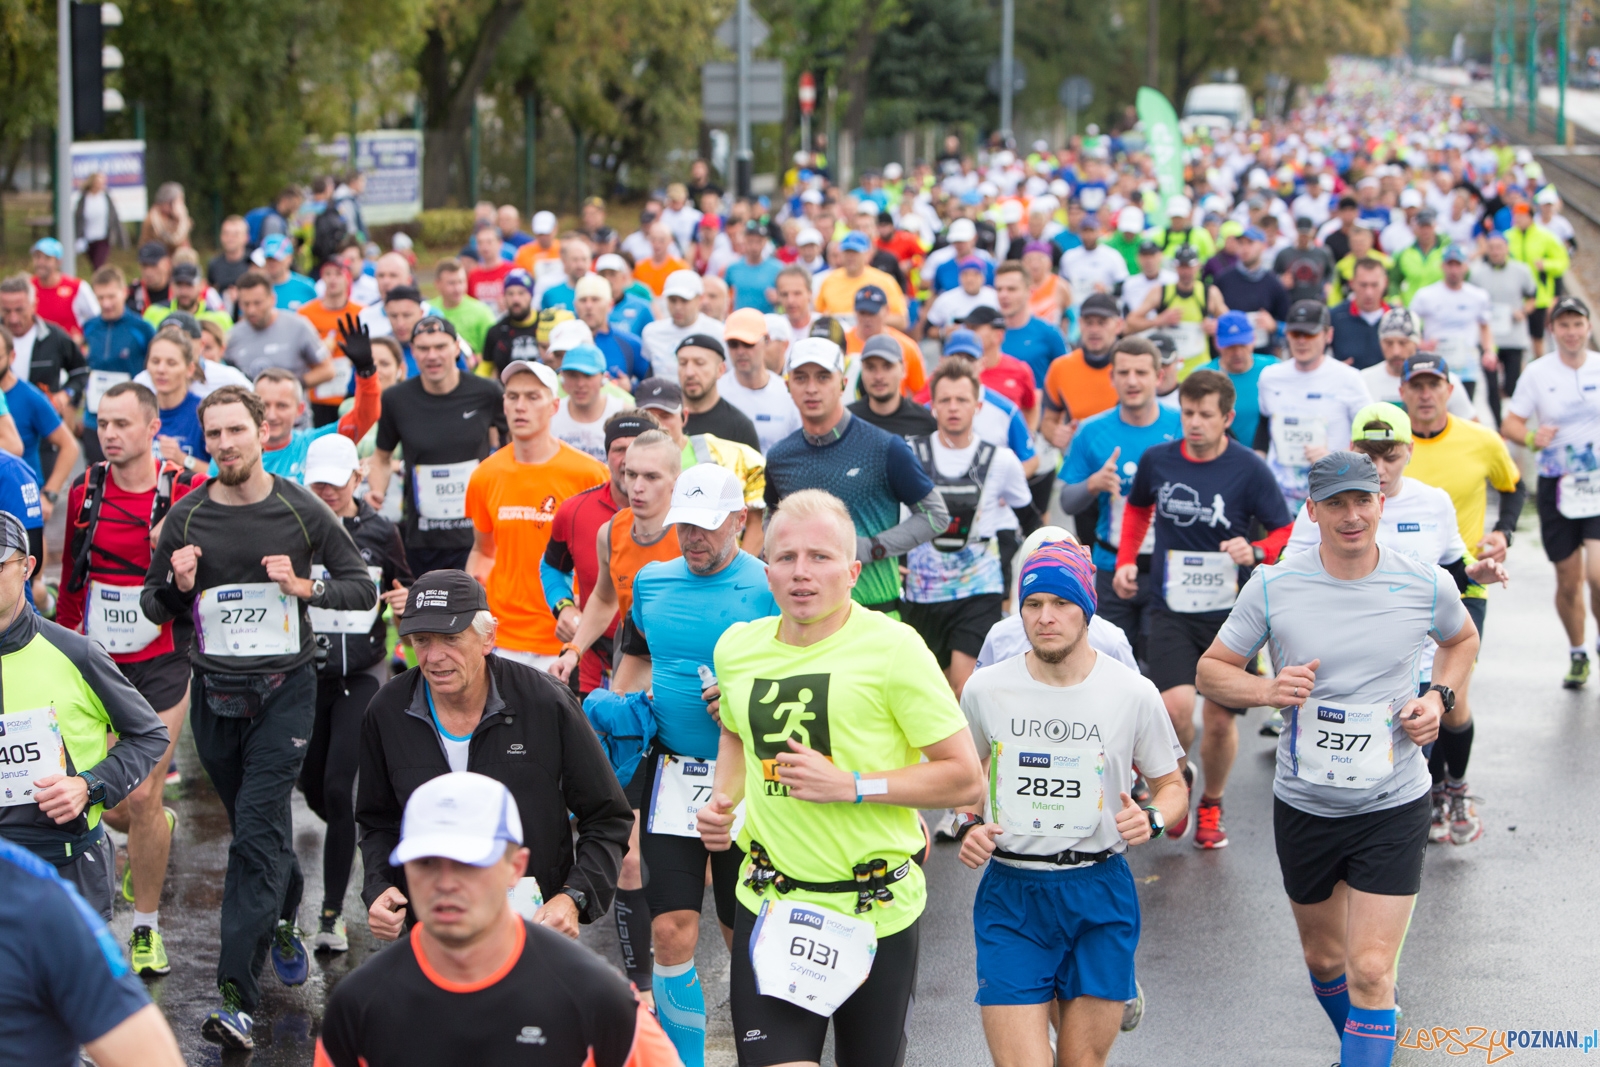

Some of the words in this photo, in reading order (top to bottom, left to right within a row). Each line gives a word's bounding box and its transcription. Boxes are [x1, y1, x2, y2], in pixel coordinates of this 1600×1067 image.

[1182, 572, 1224, 587] 2895
[103, 607, 138, 624] 1910
[220, 608, 267, 624] 2727
[230, 627, 258, 635] Łukasz
[1011, 718, 1102, 744] URODA
[1316, 729, 1372, 752] 2377
[1331, 754, 1353, 764] Piotr
[0, 769, 29, 780] Janusz
[692, 784, 713, 803] 77
[1016, 776, 1081, 799] 2823
[1032, 801, 1065, 811] Marcin
[789, 936, 839, 970] 6131
[789, 962, 827, 982] Szymon
